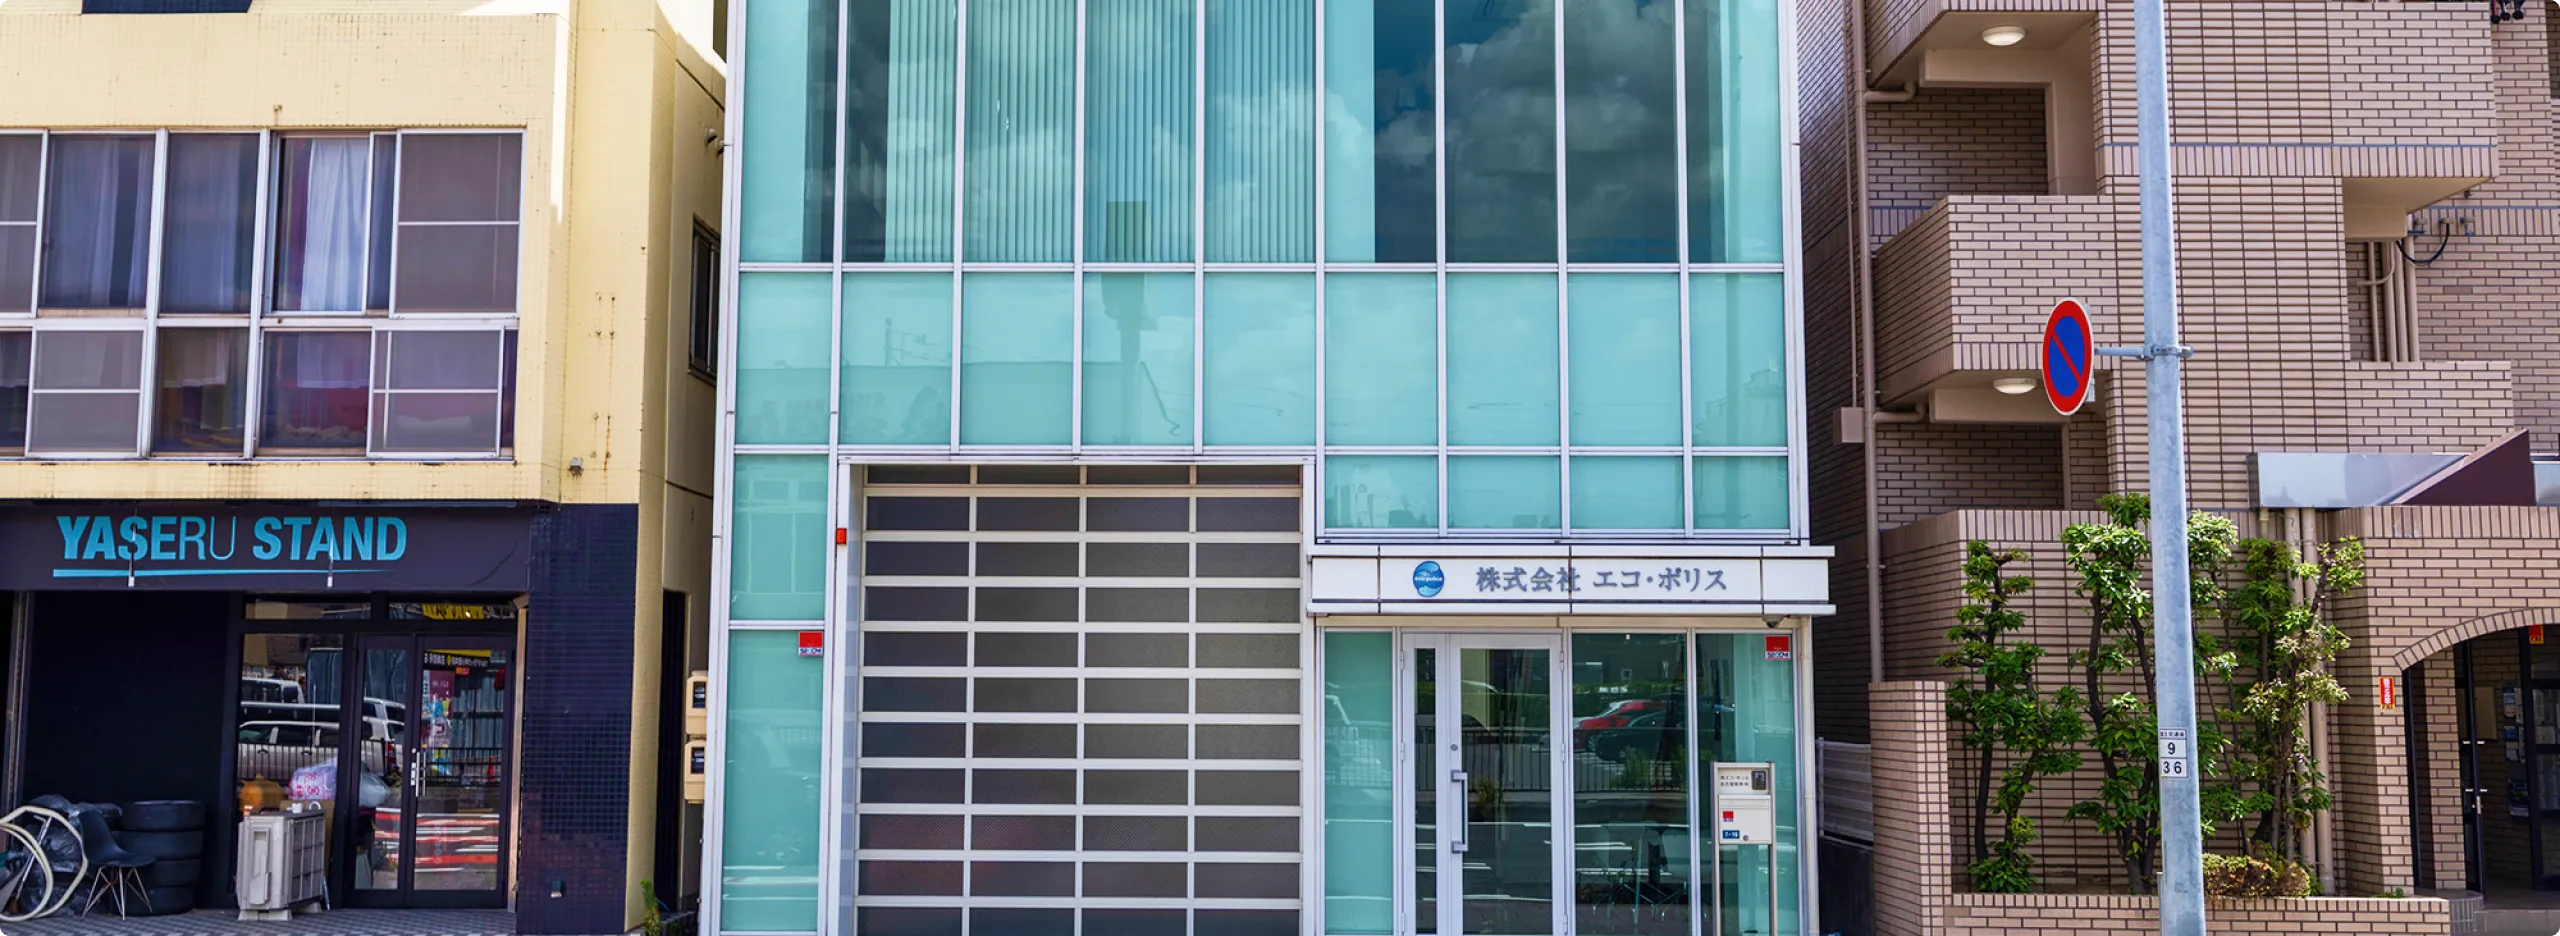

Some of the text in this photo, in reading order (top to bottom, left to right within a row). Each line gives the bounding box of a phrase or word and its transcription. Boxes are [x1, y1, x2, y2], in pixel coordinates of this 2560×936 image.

[55, 515, 408, 561] YASERU STAND
[1476, 566, 1727, 592] 株式会社 エコ・ポリス
[2167, 742, 2176, 755] 9
[2163, 761, 2182, 774] 36
